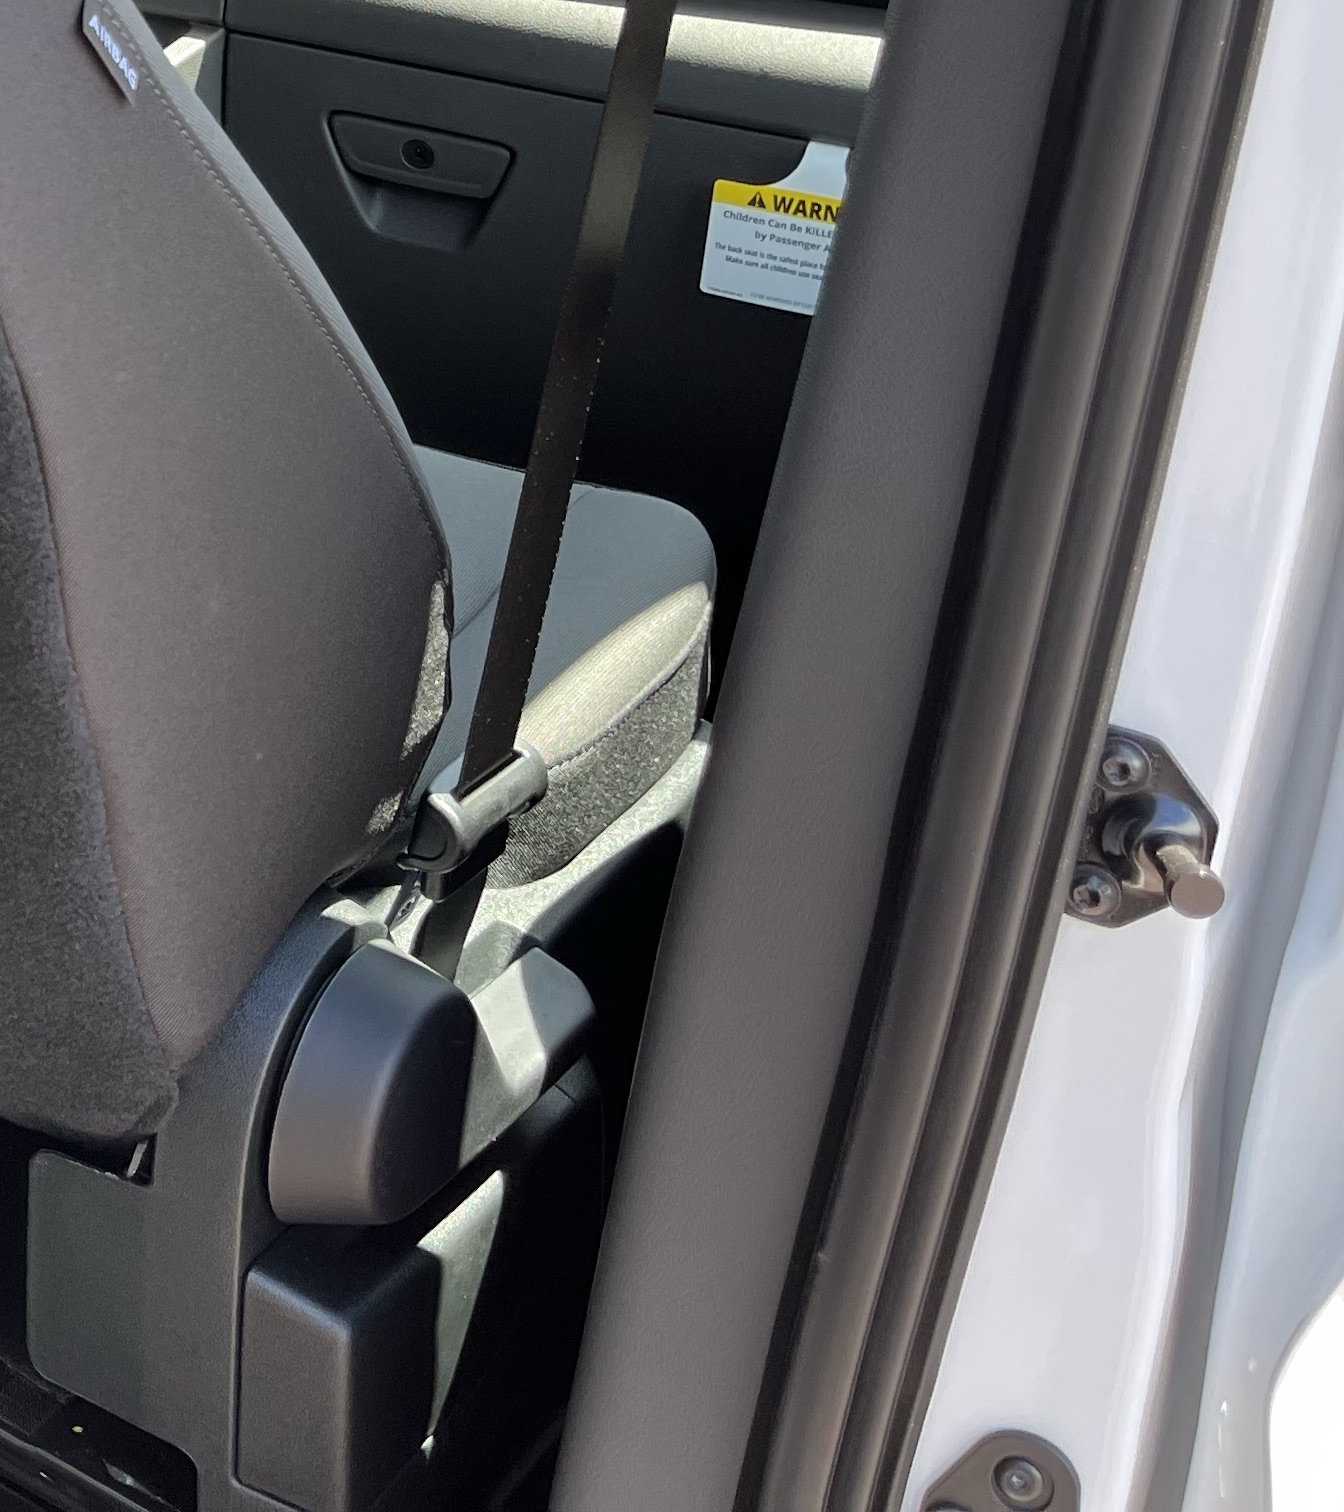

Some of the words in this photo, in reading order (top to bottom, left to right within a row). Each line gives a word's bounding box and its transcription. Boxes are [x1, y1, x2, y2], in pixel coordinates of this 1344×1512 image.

[88, 14, 139, 90] AIRBAG
[723, 210, 766, 225] Children
[768, 219, 787, 230] Can
[790, 223, 803, 233] Be
[714, 241, 727, 250] The
[754, 230, 767, 242] by
[769, 233, 822, 251] Passenger
[725, 255, 743, 264] Make
